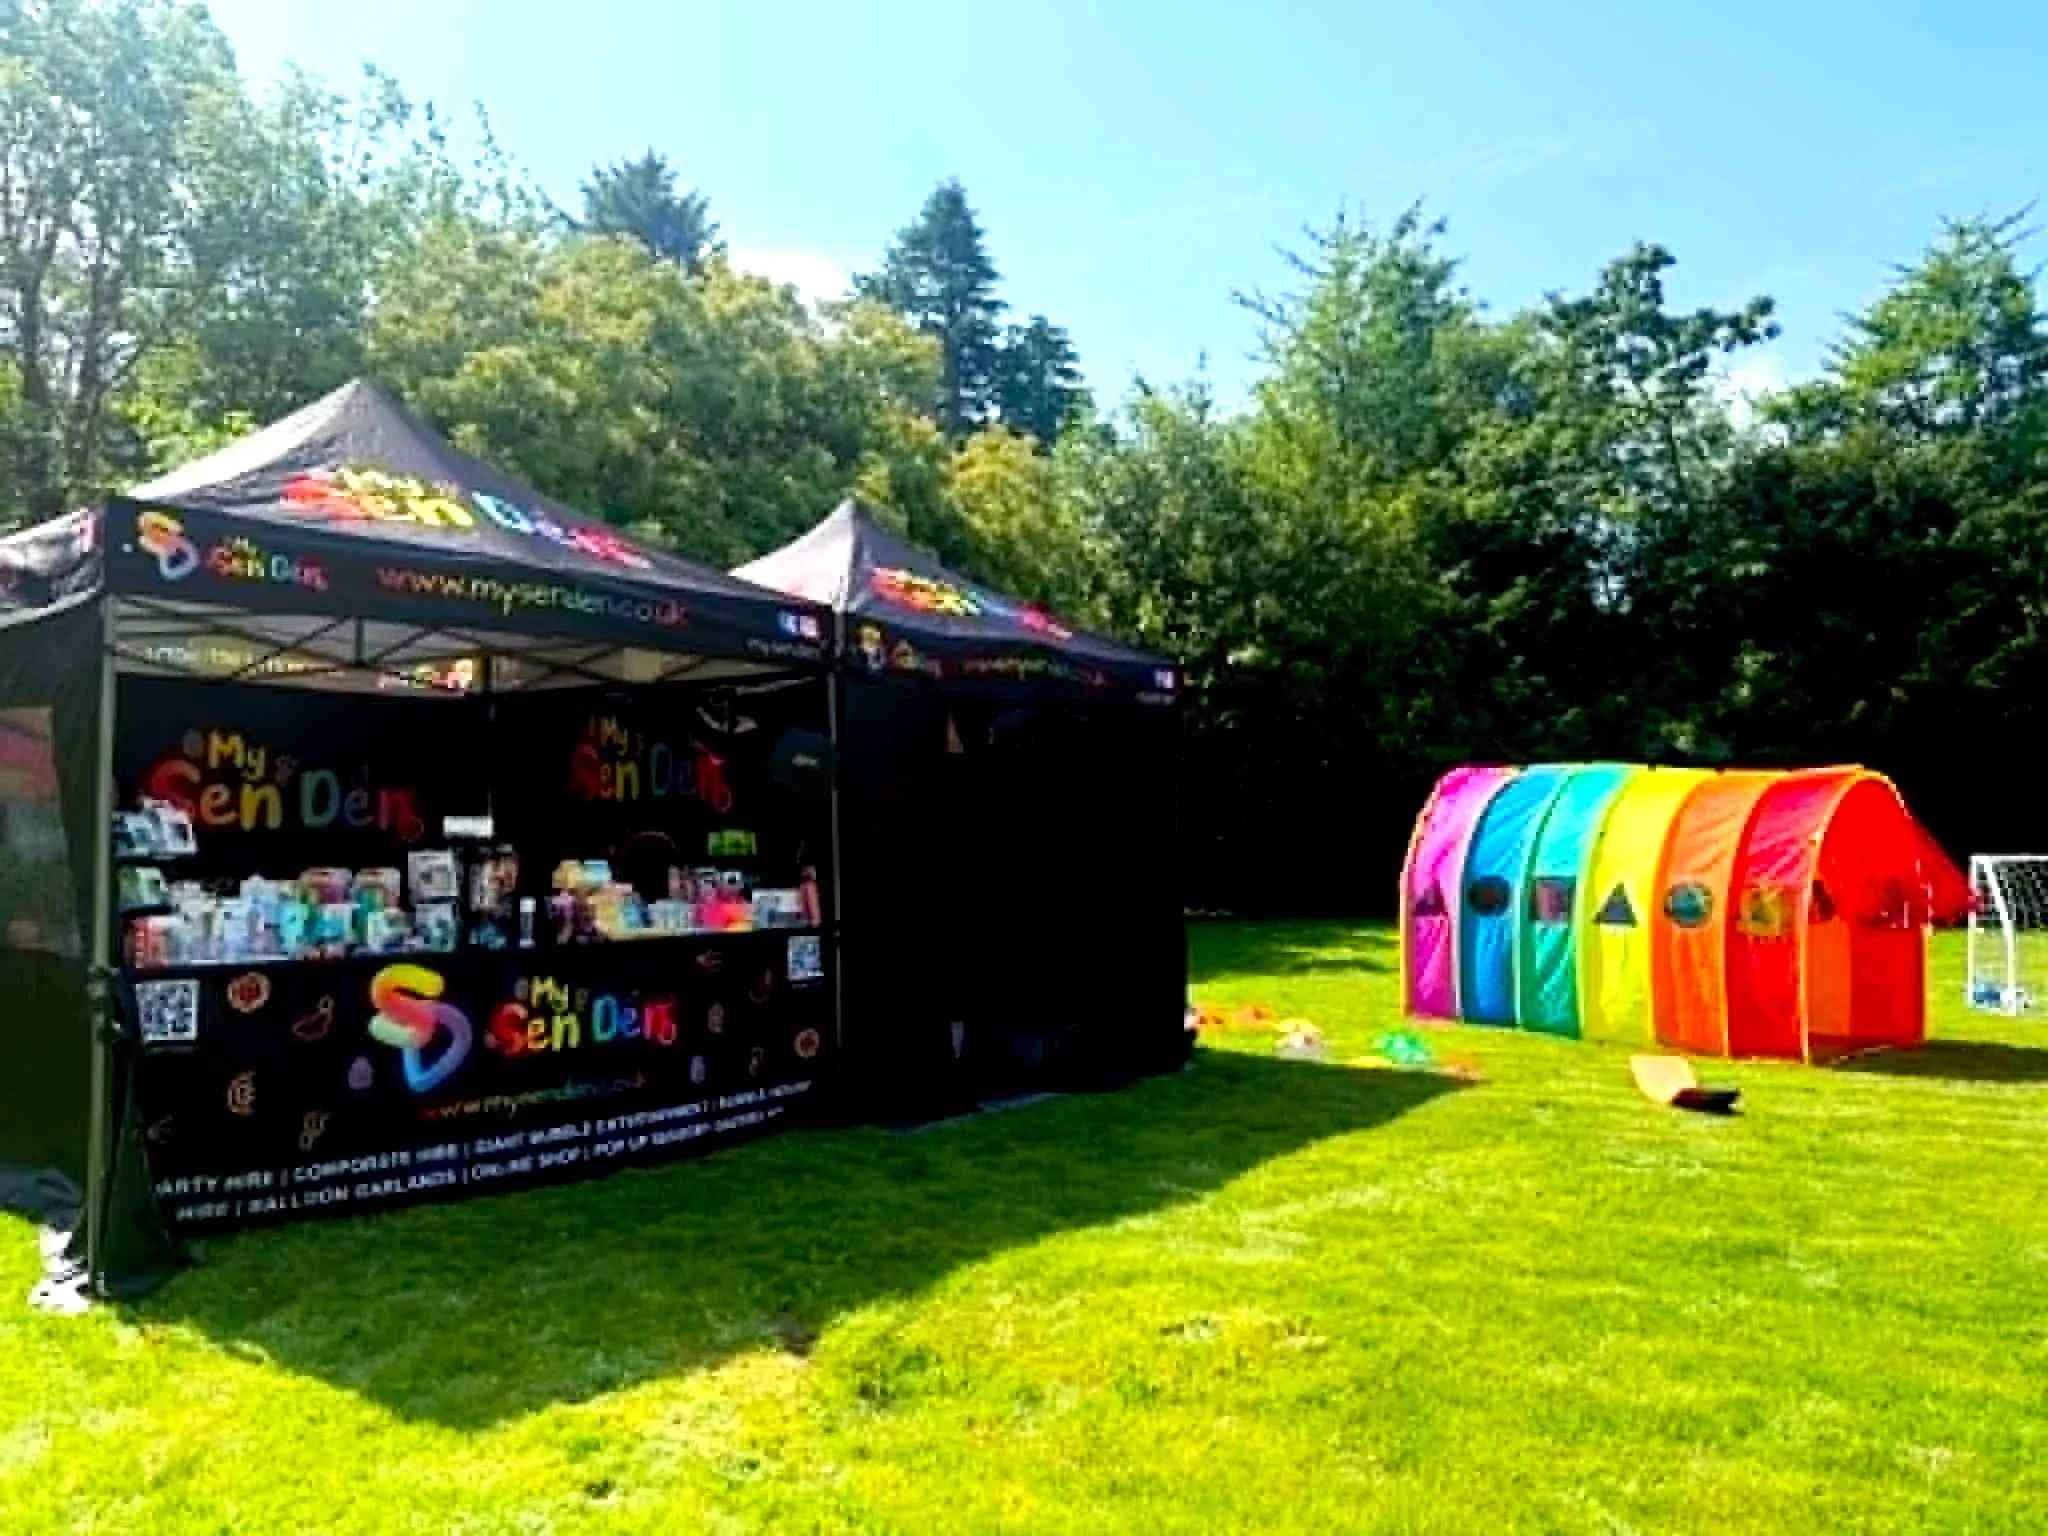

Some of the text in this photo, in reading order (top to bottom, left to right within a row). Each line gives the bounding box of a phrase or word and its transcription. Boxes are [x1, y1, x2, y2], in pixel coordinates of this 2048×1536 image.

[207, 728, 266, 781] My
[144, 758, 284, 833] Sen
[531, 976, 570, 1010] My
[484, 1002, 581, 1055] Sen
[155, 1175, 219, 1196] ARTY
